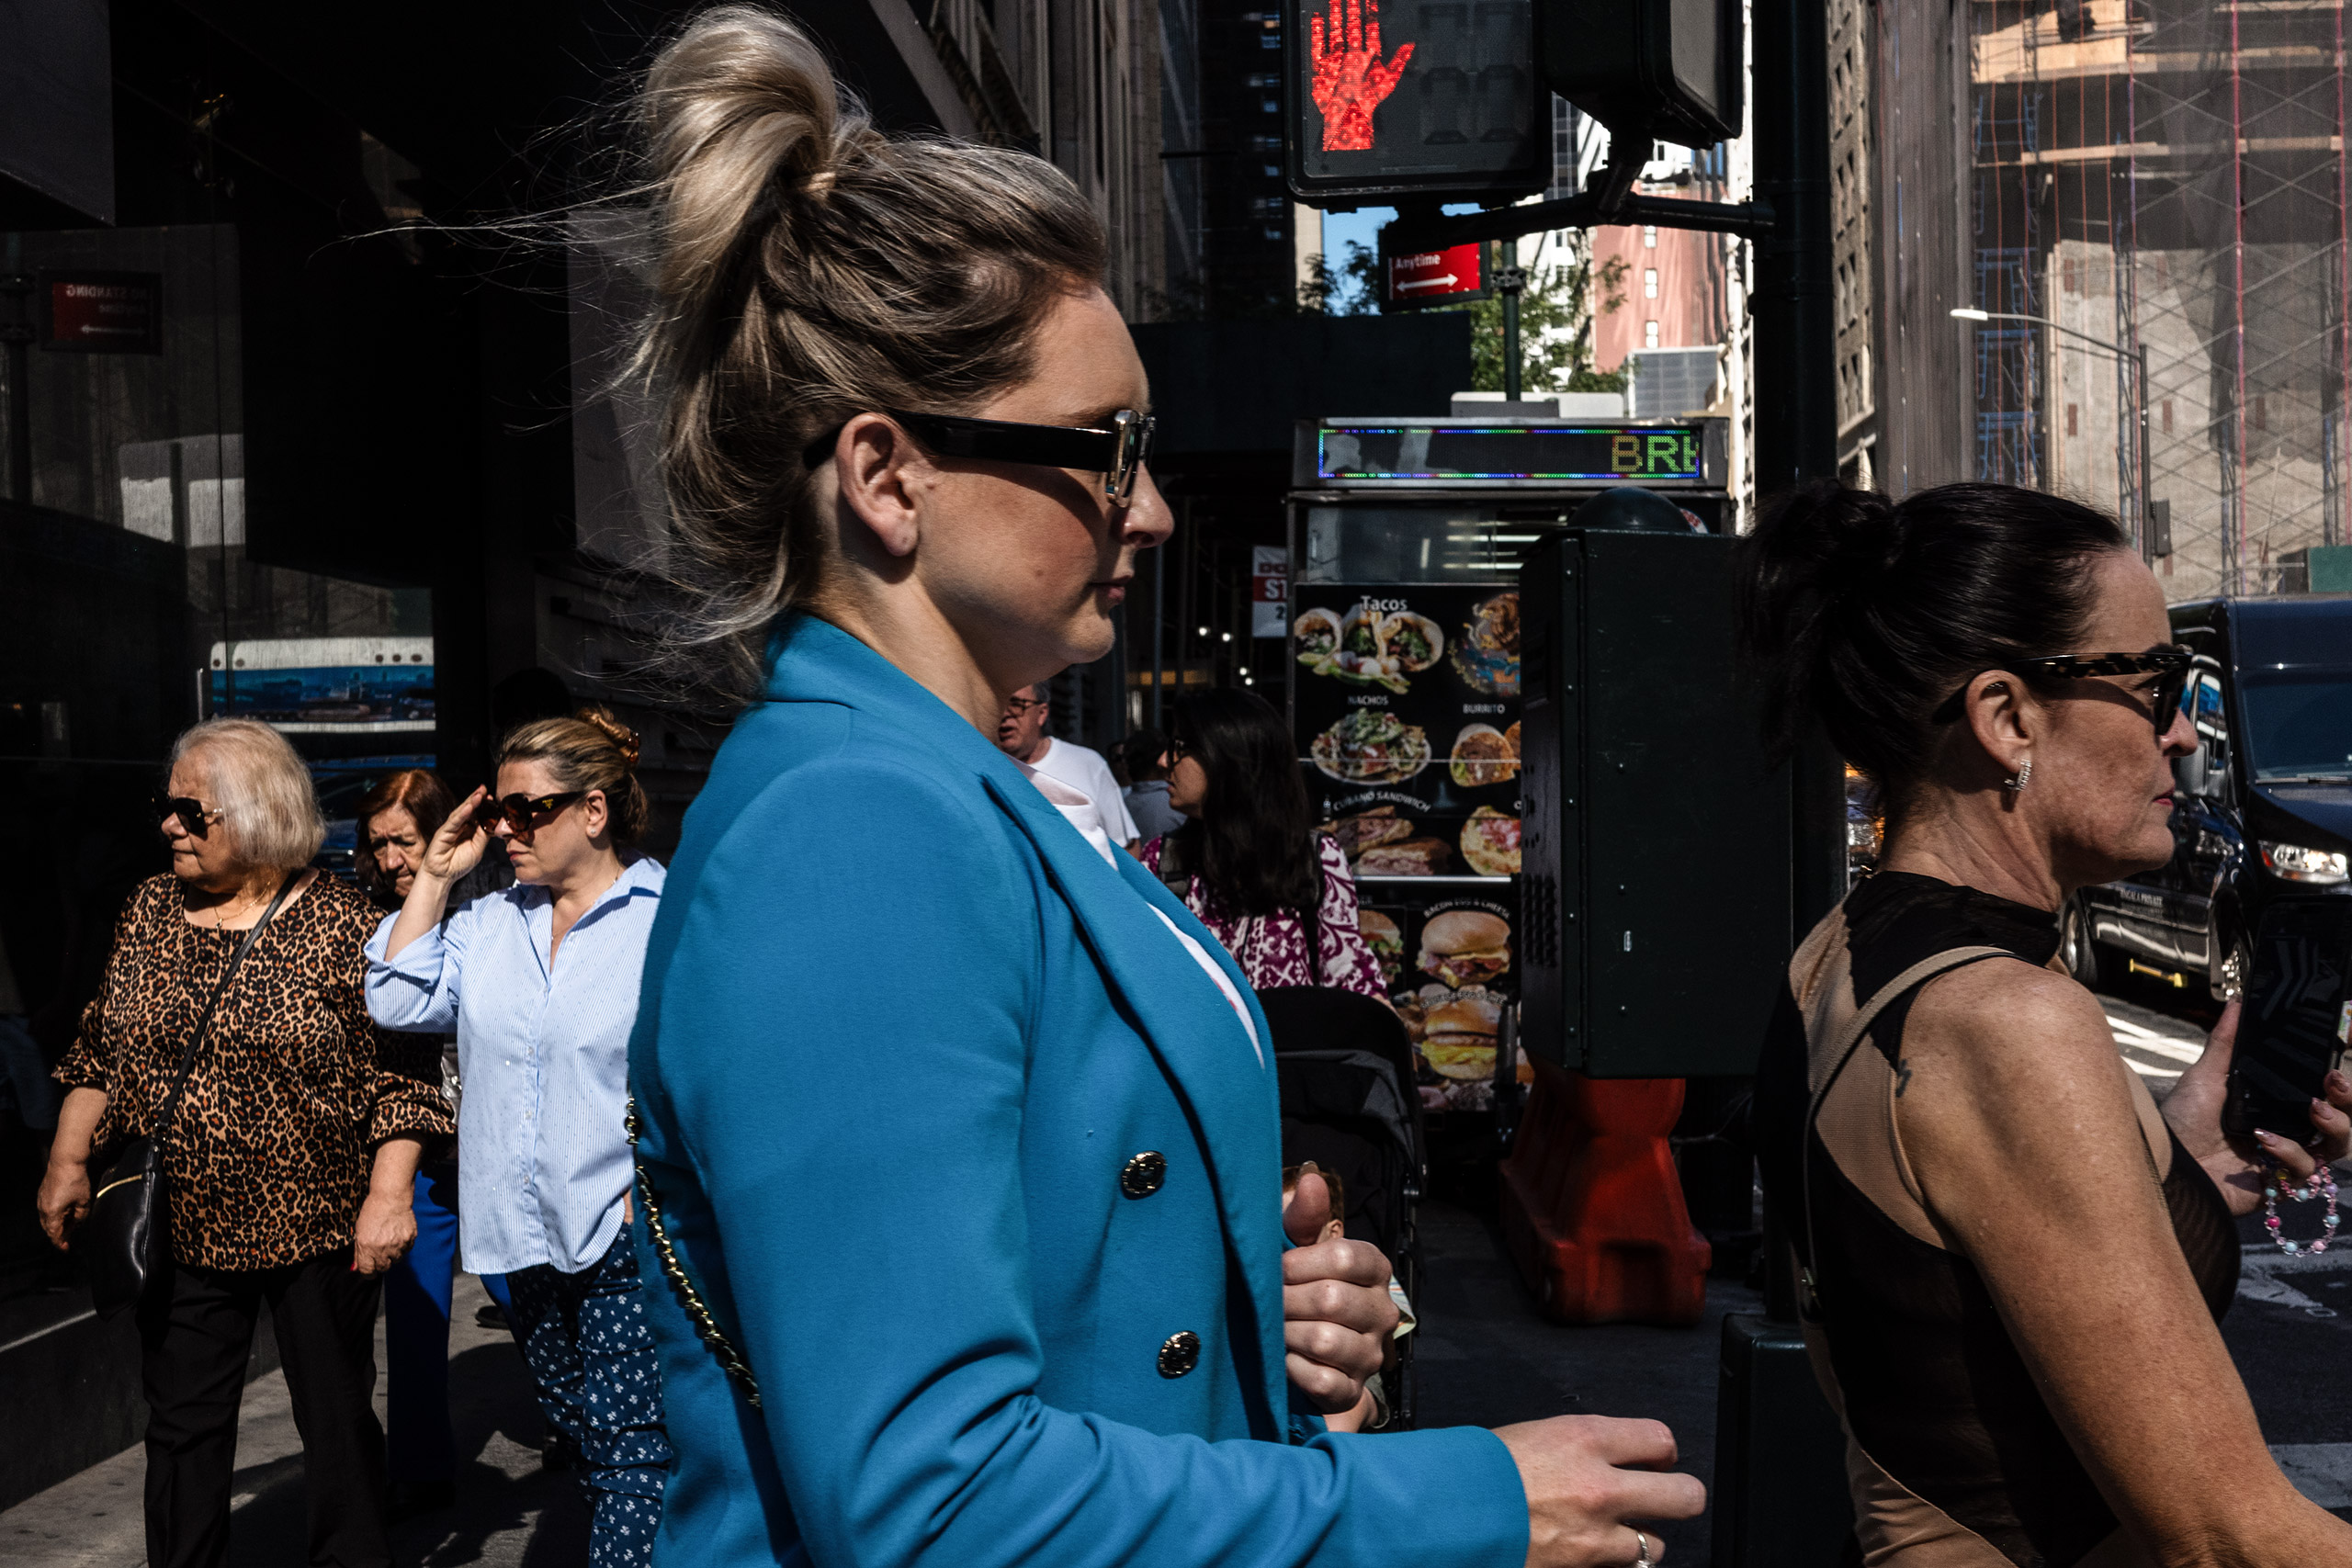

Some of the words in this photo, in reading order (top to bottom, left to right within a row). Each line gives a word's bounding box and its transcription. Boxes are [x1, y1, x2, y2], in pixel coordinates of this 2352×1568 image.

[1395, 254, 1441, 270] Anytime
[1360, 595, 1408, 611] Tacos
[1347, 695, 1389, 706] NACHOS
[1463, 703, 1506, 715] BURRITO
[1375, 791, 1432, 813] SANDWICH
[1423, 900, 1453, 919] BACON
[1481, 899, 1510, 920] CHEESE
